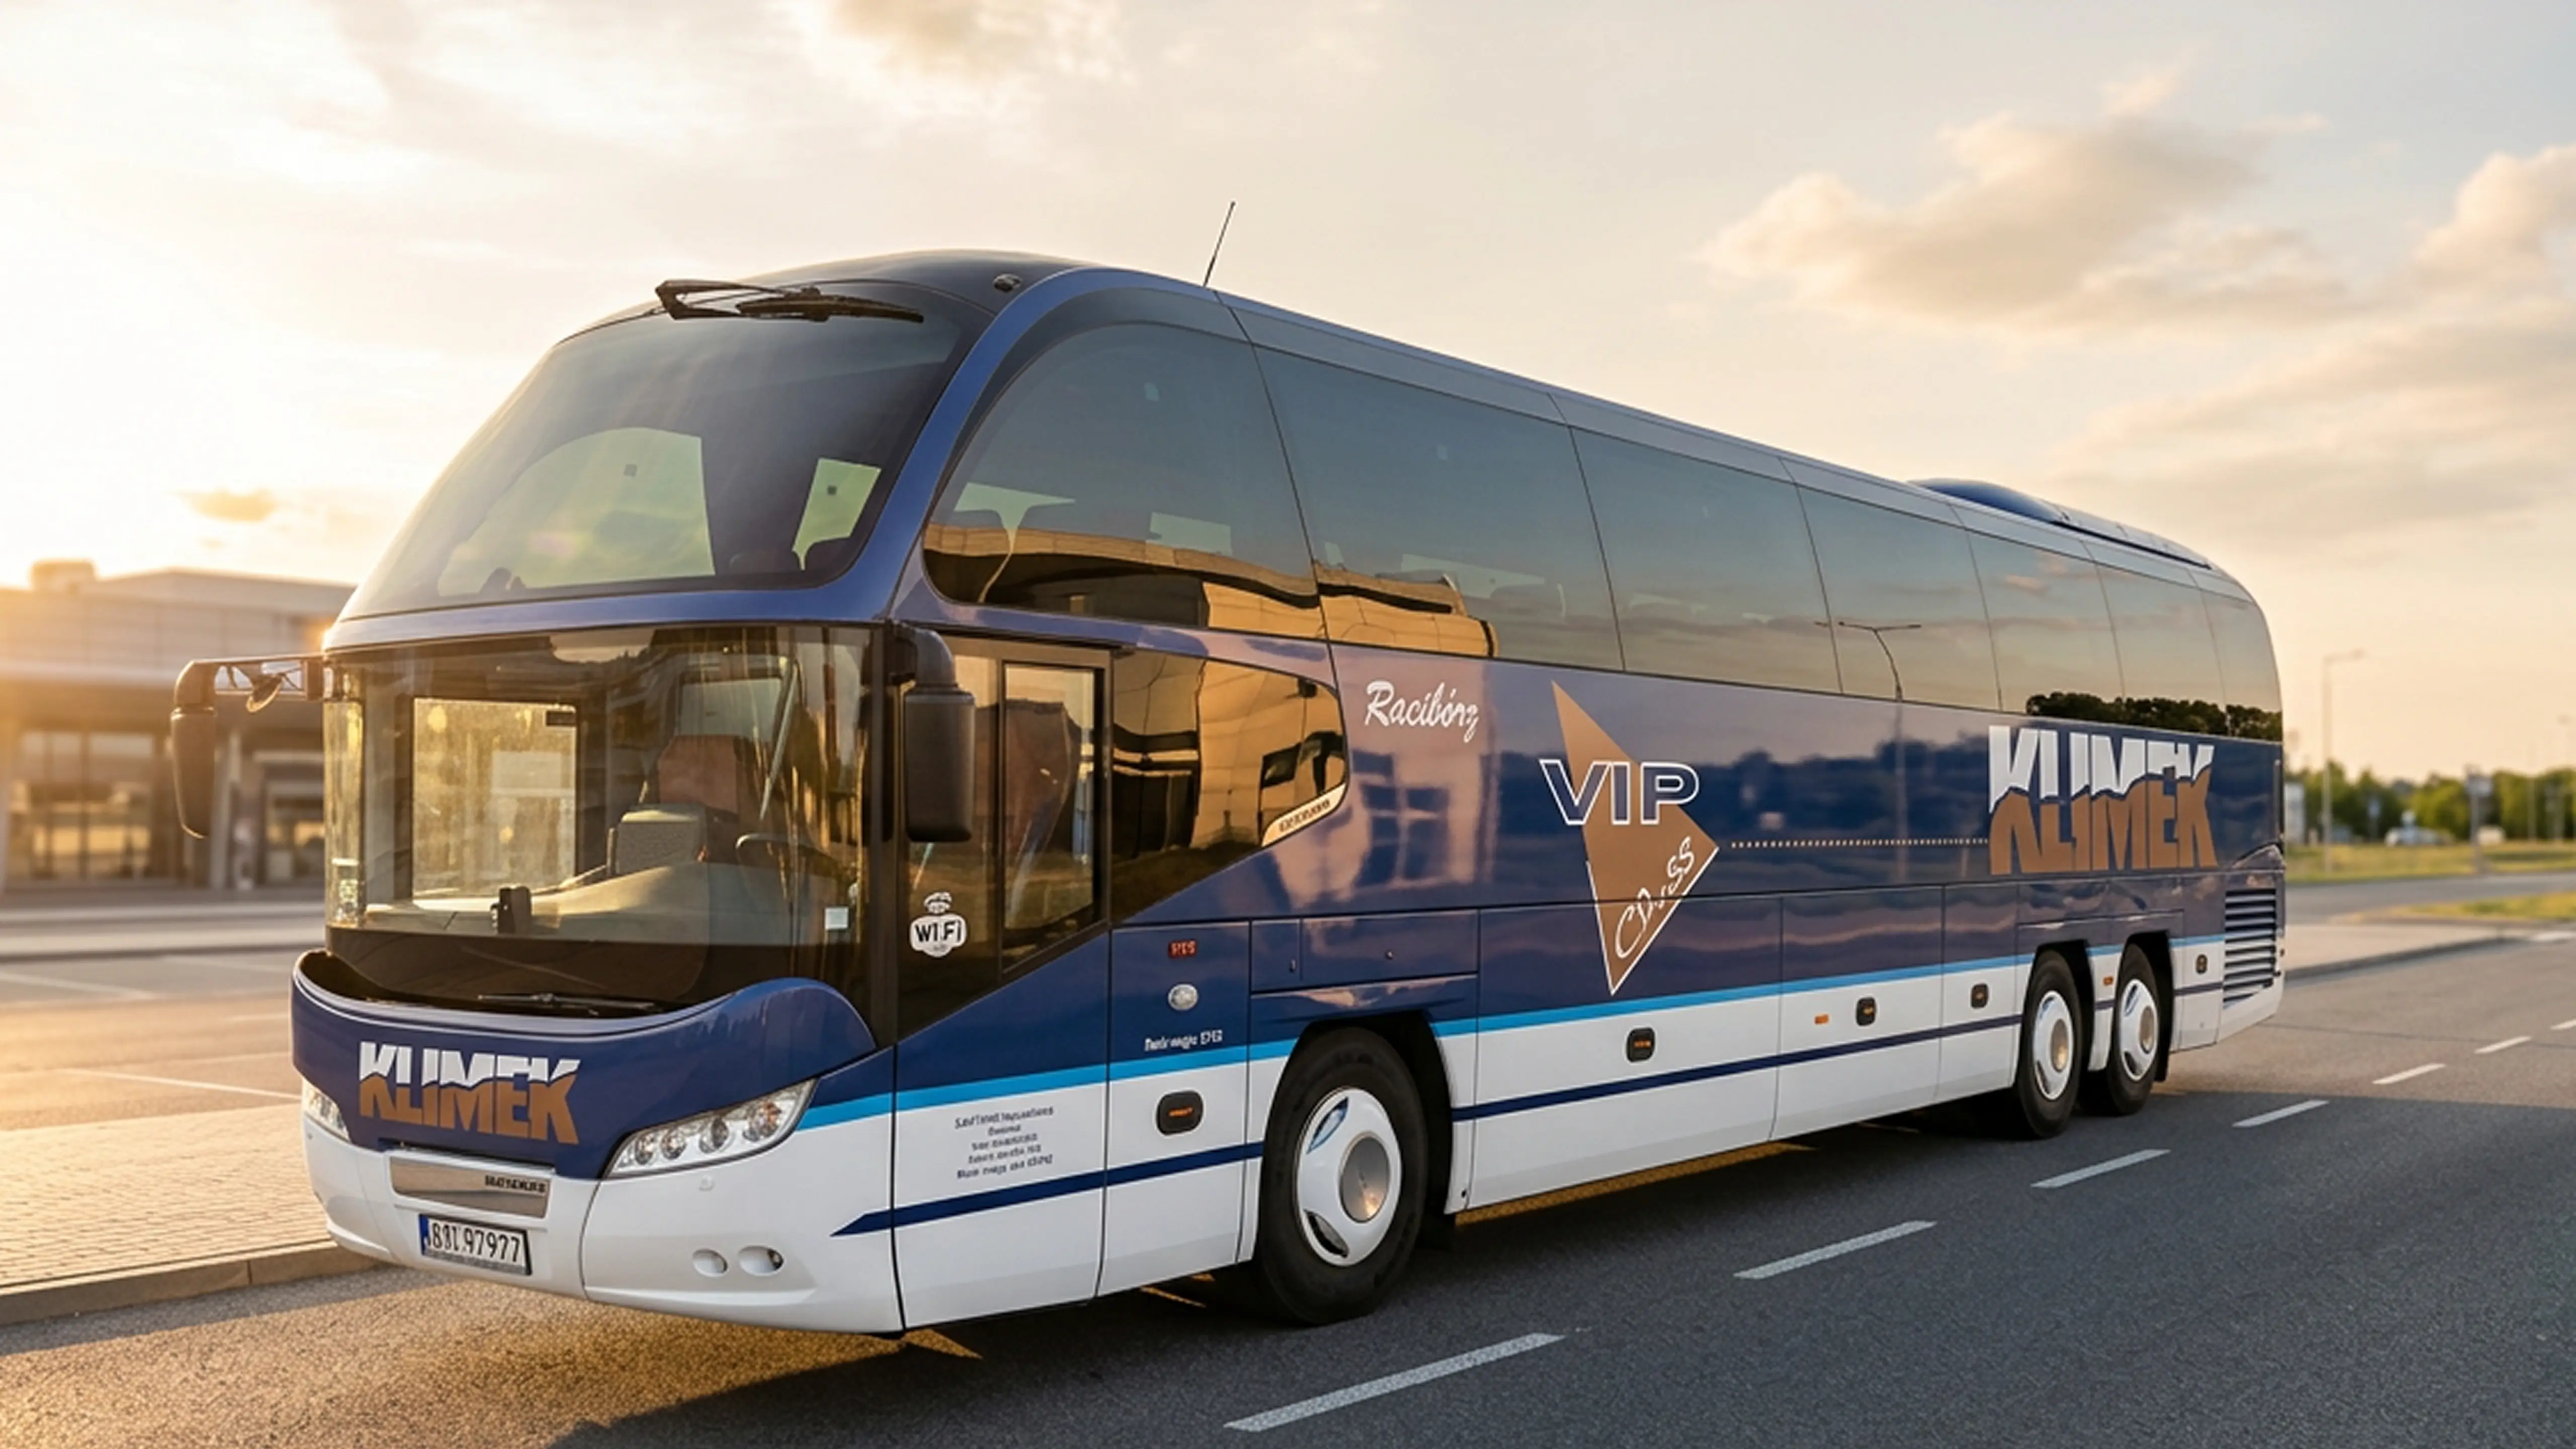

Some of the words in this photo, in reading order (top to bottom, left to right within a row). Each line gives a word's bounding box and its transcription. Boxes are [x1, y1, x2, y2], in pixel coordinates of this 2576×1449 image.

[1364, 680, 1480, 743] Racibórz
[1538, 759, 1700, 825] VIP
[1988, 725, 2218, 875] KLIMEK
[359, 1041, 581, 1145] KLIMEK
